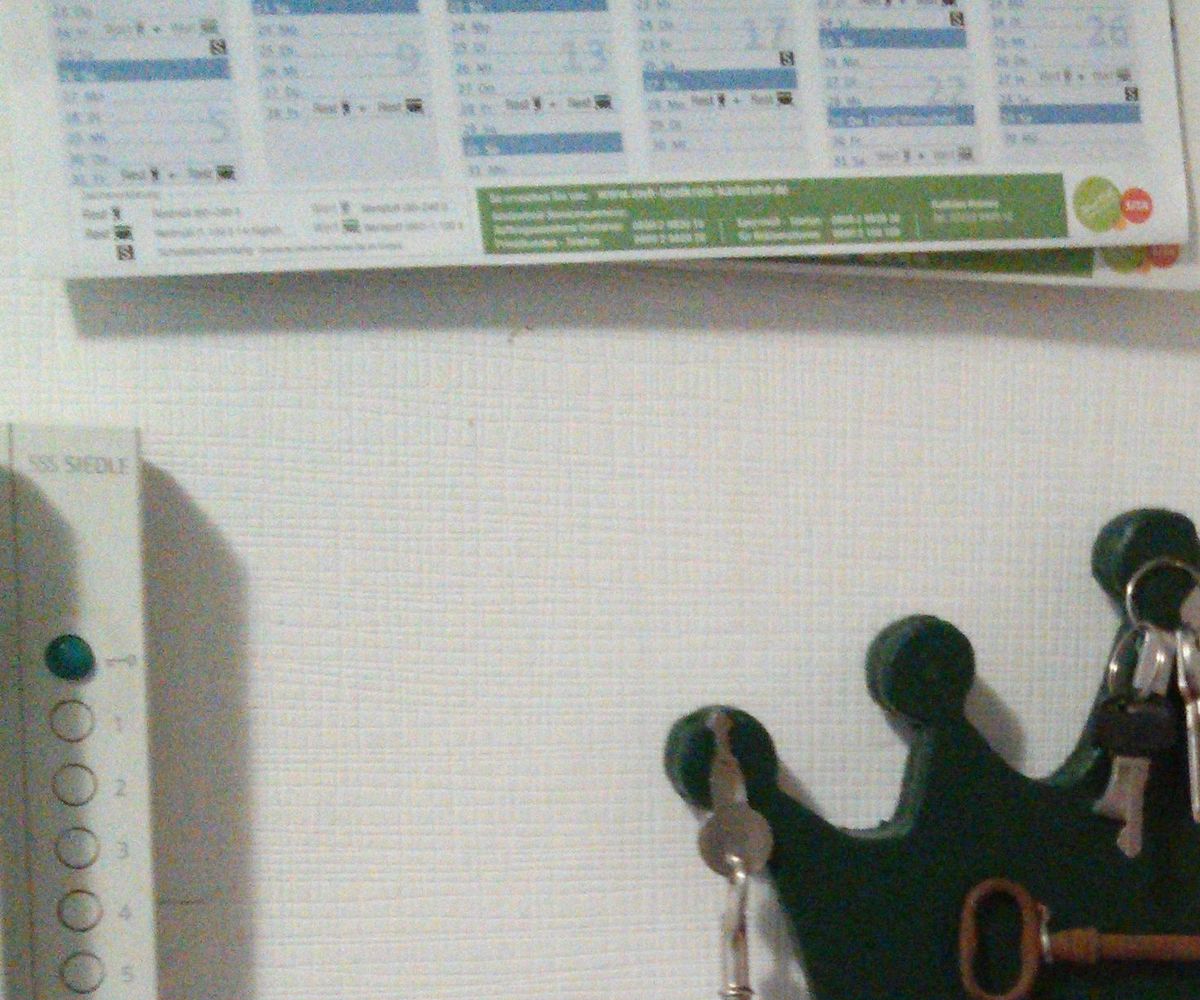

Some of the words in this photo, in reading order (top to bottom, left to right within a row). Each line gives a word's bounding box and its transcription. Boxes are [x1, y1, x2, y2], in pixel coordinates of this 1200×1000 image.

[114, 778, 127, 798] 2
[117, 841, 130, 860] 3
[117, 904, 133, 922] 4
[121, 964, 135, 984] 5
